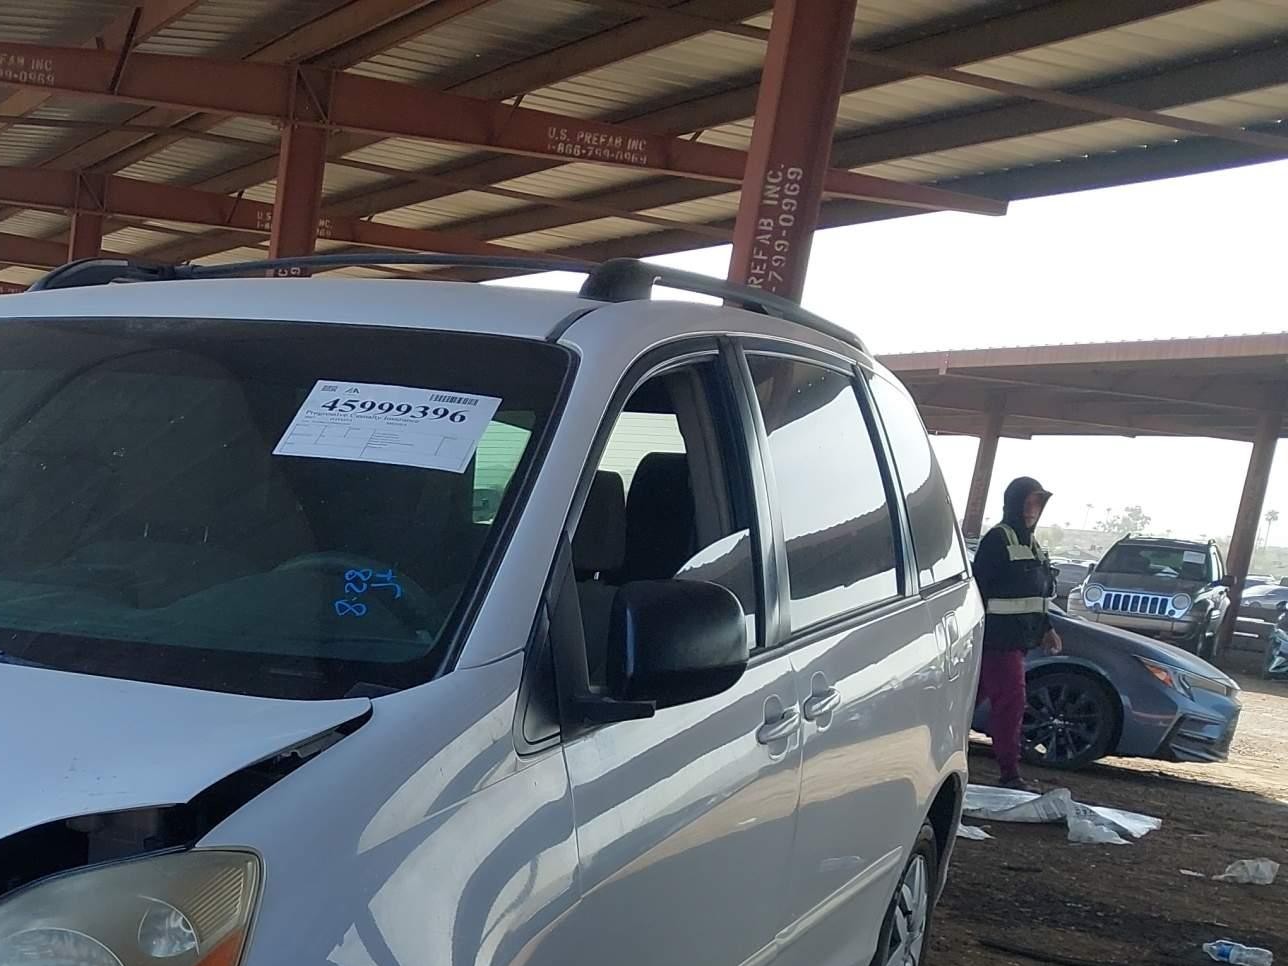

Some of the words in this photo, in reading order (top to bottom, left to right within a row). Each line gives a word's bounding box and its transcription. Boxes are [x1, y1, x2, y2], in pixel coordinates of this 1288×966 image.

[547, 126, 570, 142] U.S.
[576, 130, 623, 148] PREFAB
[320, 398, 470, 424] 45999396
